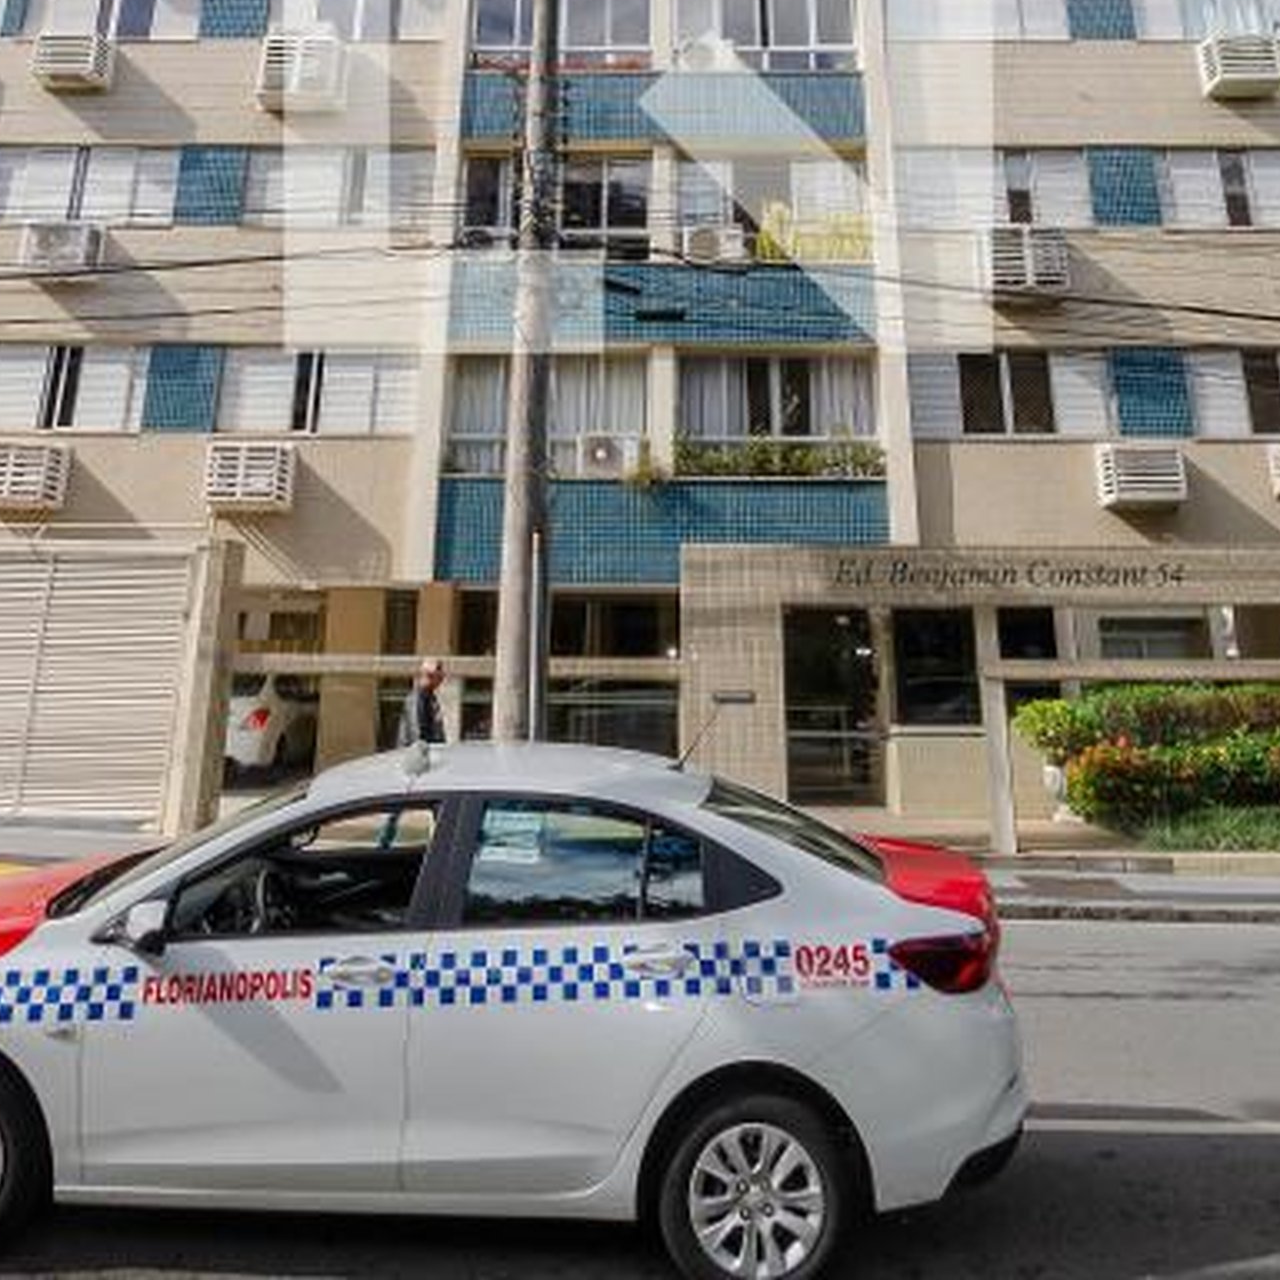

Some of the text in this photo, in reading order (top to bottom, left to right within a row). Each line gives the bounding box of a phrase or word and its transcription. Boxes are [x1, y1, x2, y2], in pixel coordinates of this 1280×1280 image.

[887, 560, 1018, 592] Benjamin
[1027, 559, 1150, 588] Constant
[1155, 563, 1187, 588] 54
[795, 944, 870, 978] 0245
[142, 969, 313, 1005] FLORIANOPOLIS
